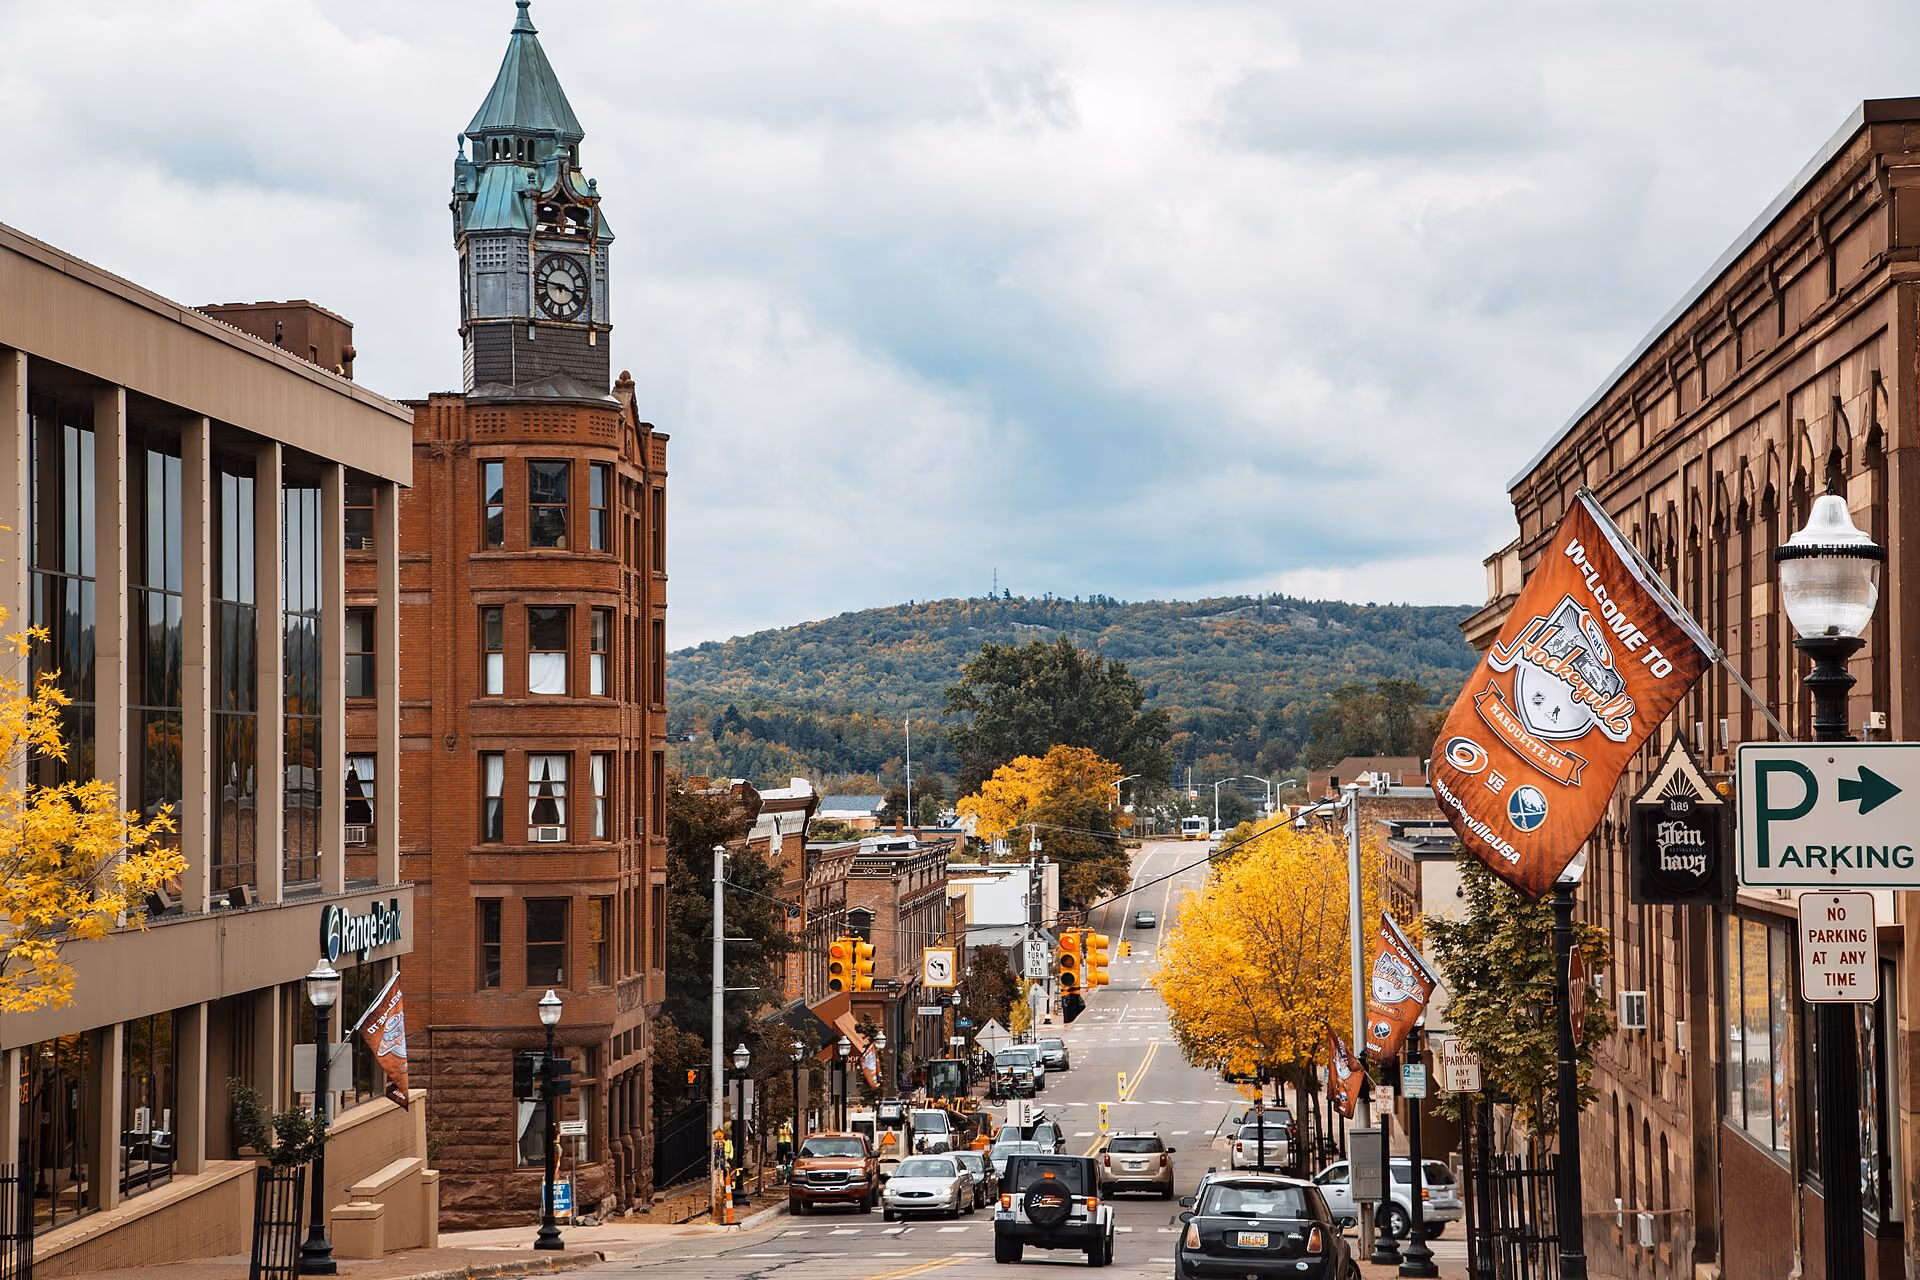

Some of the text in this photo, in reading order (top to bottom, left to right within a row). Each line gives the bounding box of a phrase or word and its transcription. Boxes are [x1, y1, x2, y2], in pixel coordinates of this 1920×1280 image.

[1564, 538, 1673, 679] WELCOME TO
[1588, 625, 1604, 658] Kraft
[1490, 618, 1635, 735] Hockeyville
[1487, 773, 1505, 791] VS
[1670, 799, 1689, 812] das
[1656, 820, 1705, 846] Stein
[1827, 908, 1846, 921] NO
[1809, 929, 1867, 943] PARKING
[1030, 943, 1041, 951] NO
[1381, 928, 1419, 970] WELCOME
[1420, 971, 1431, 984] TO
[1812, 951, 1866, 965] AT ANY
[1030, 967, 1043, 975] RED
[1824, 973, 1856, 986] TIME
[1454, 1044, 1467, 1054] NO
[1446, 1055, 1478, 1066] PARKING
[1455, 1069, 1470, 1077] ANY
